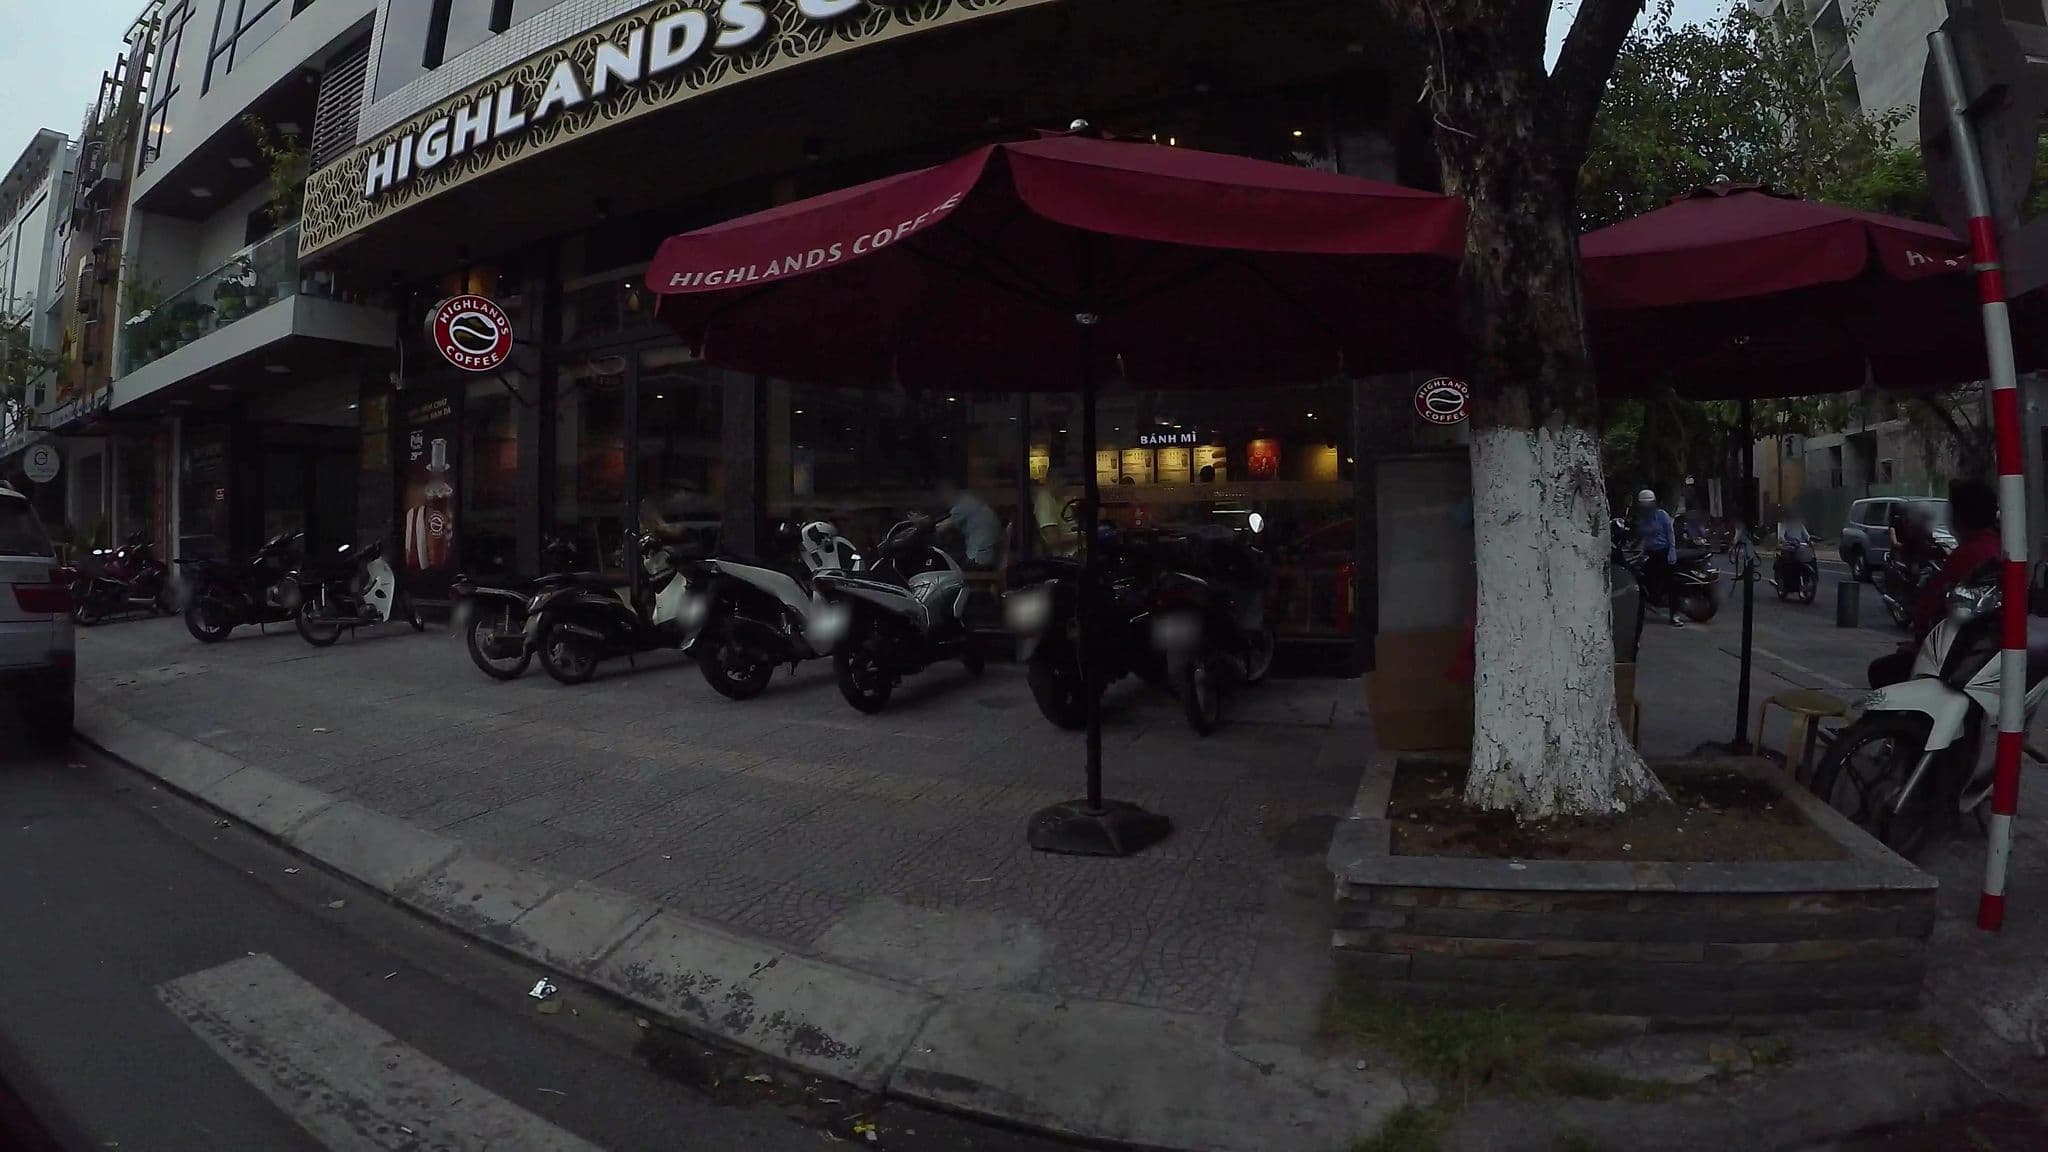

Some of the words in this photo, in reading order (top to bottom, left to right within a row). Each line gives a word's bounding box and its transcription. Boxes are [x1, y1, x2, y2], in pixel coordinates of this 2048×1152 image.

[365, 0, 767, 198] HIGHLANDS
[669, 242, 842, 286] HIGHLANDS
[440, 299, 509, 336] HIGHLANDS
[446, 345, 500, 366] COFFEE
[1425, 409, 1466, 422] COFFEE
[1140, 432, 1177, 445] BÁNH
